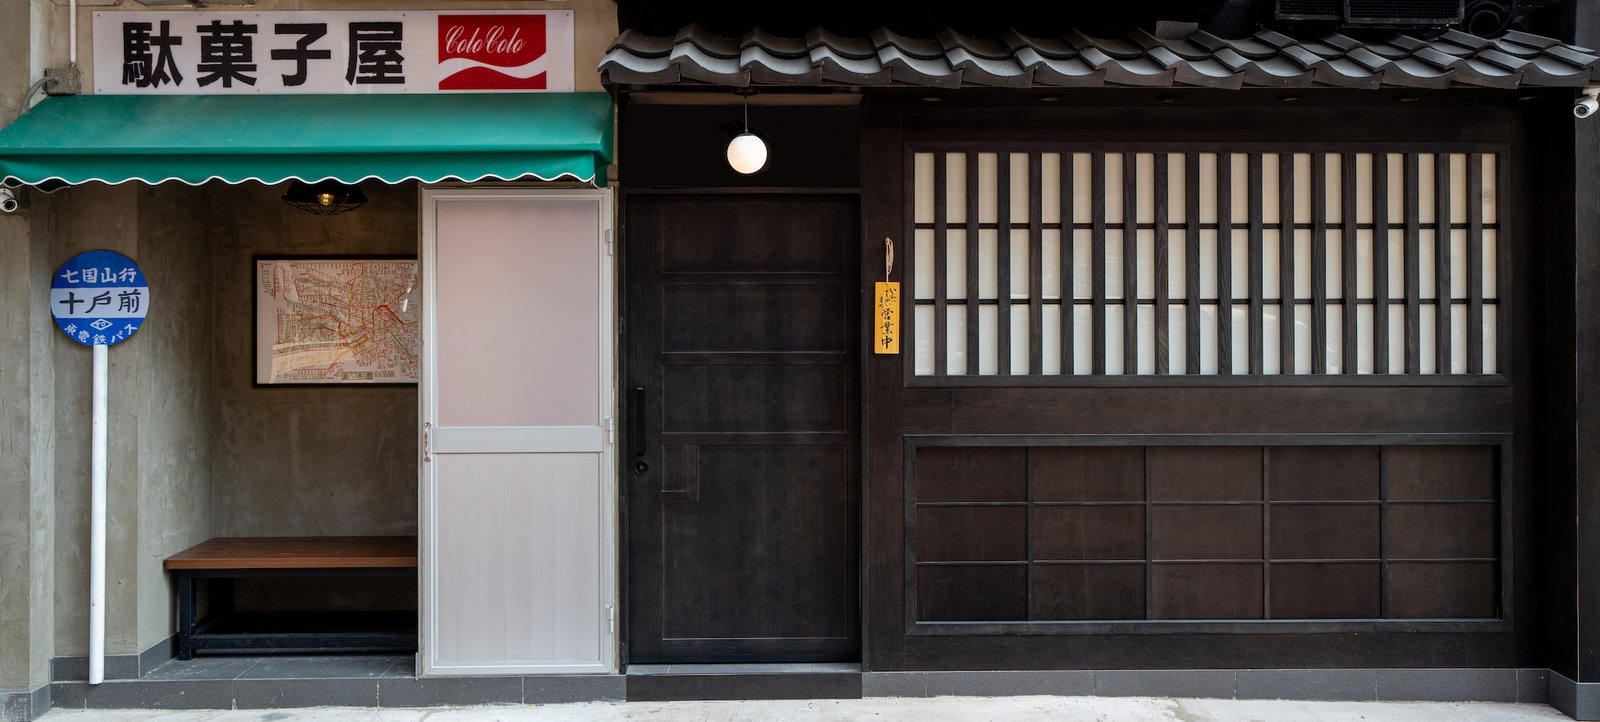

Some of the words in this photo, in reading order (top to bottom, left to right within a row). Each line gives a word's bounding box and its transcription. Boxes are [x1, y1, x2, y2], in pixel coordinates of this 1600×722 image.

[121, 20, 406, 89] 駄菓子屋
[61, 267, 137, 284] 七国山行
[880, 308, 895, 350] 営業中
